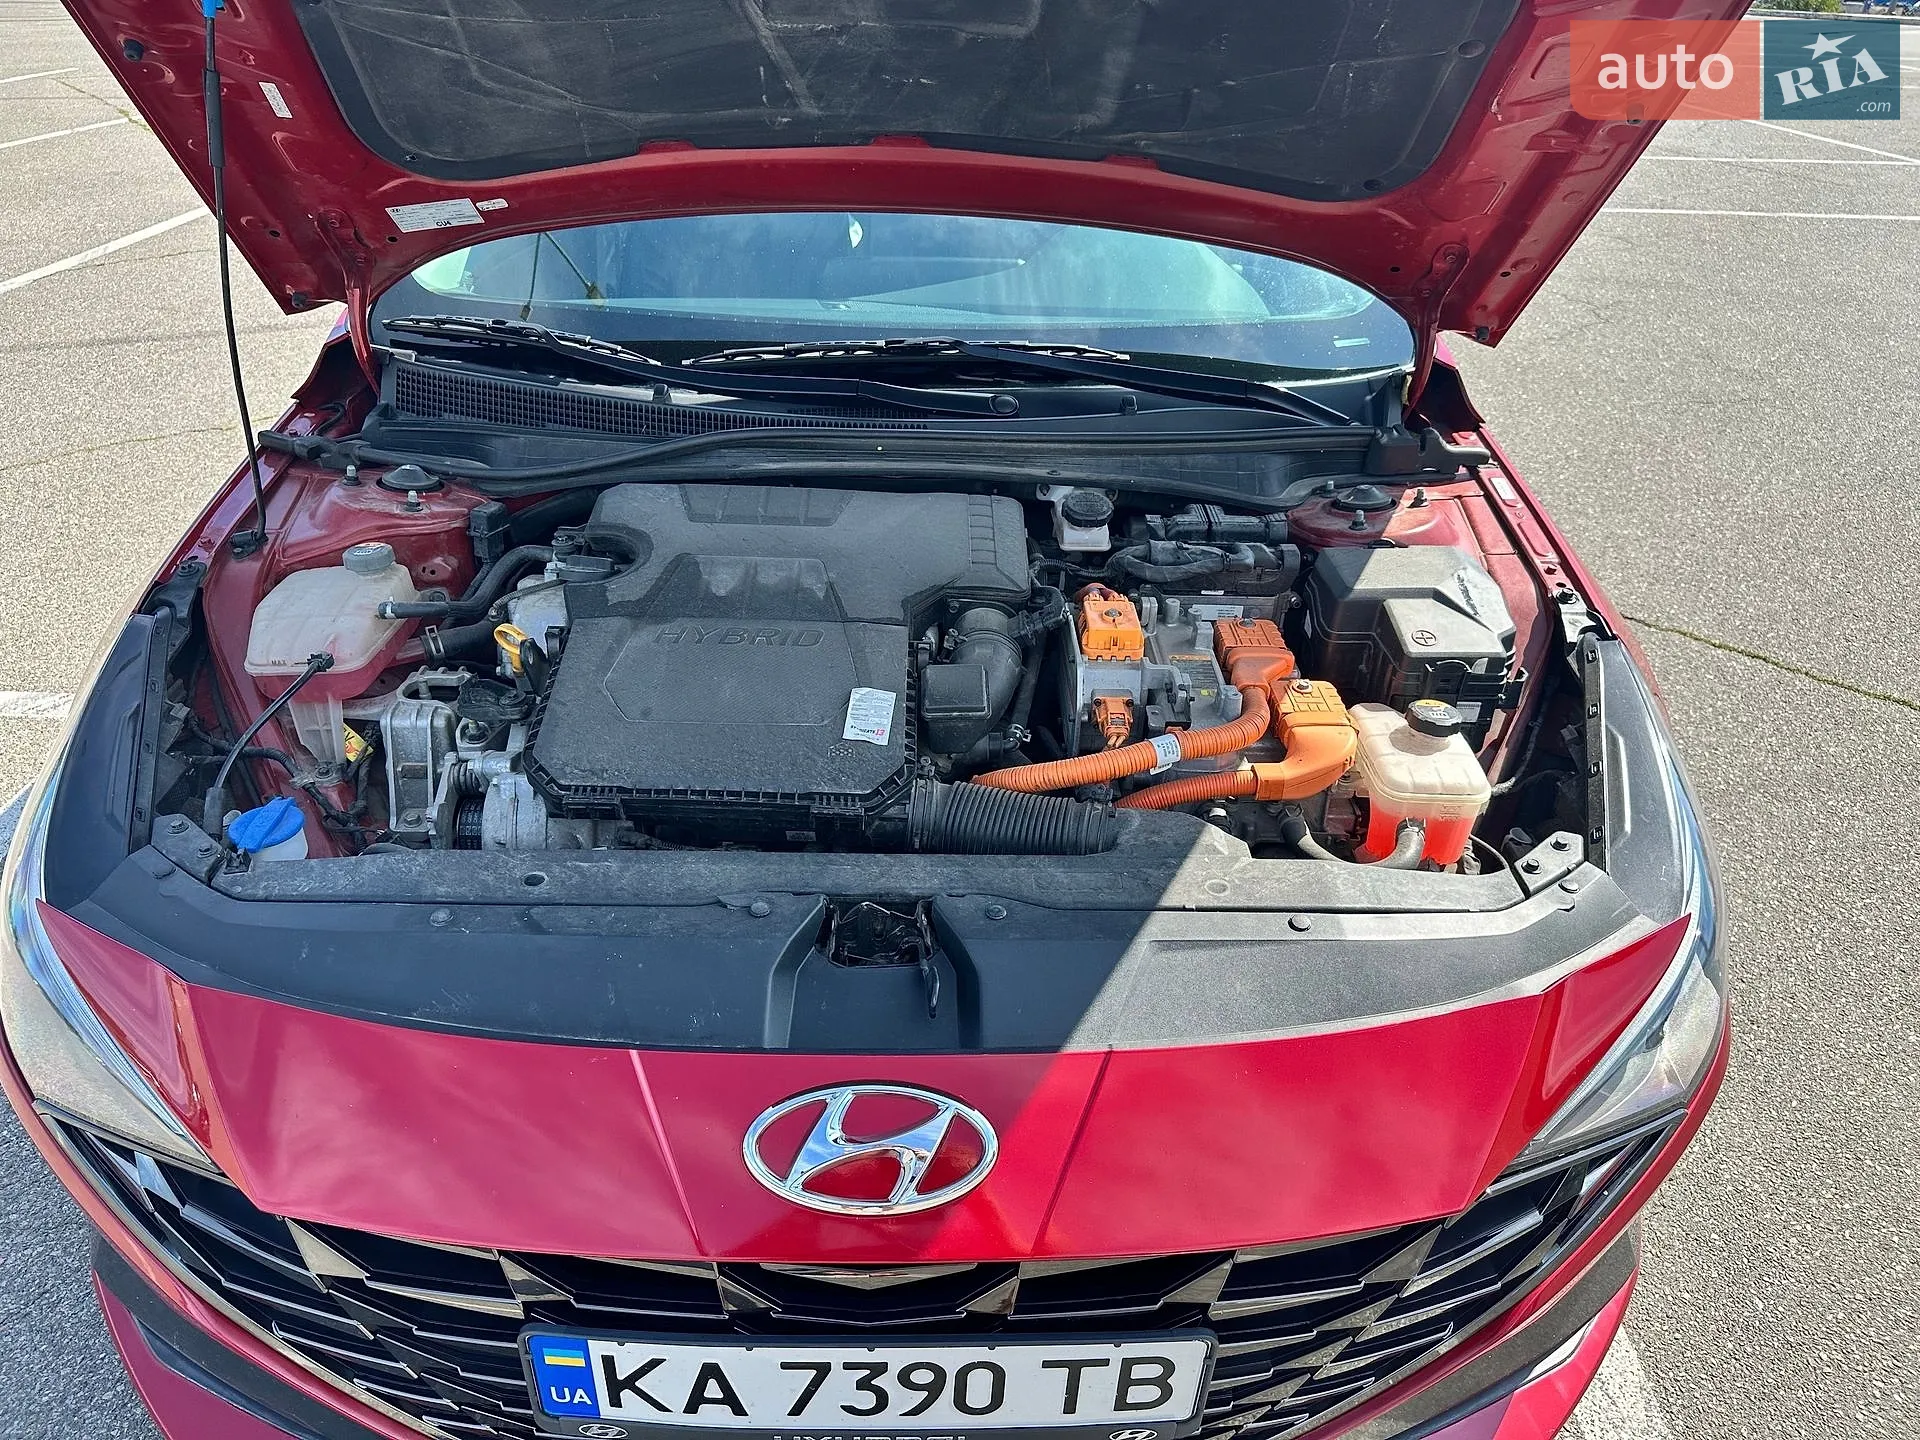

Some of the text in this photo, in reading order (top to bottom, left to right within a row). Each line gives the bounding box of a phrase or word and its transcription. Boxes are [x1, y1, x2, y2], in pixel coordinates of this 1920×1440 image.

[652, 625, 826, 647] HYBRID
[550, 1386, 593, 1405] UA
[602, 1354, 1175, 1417] KA 7390 TB
